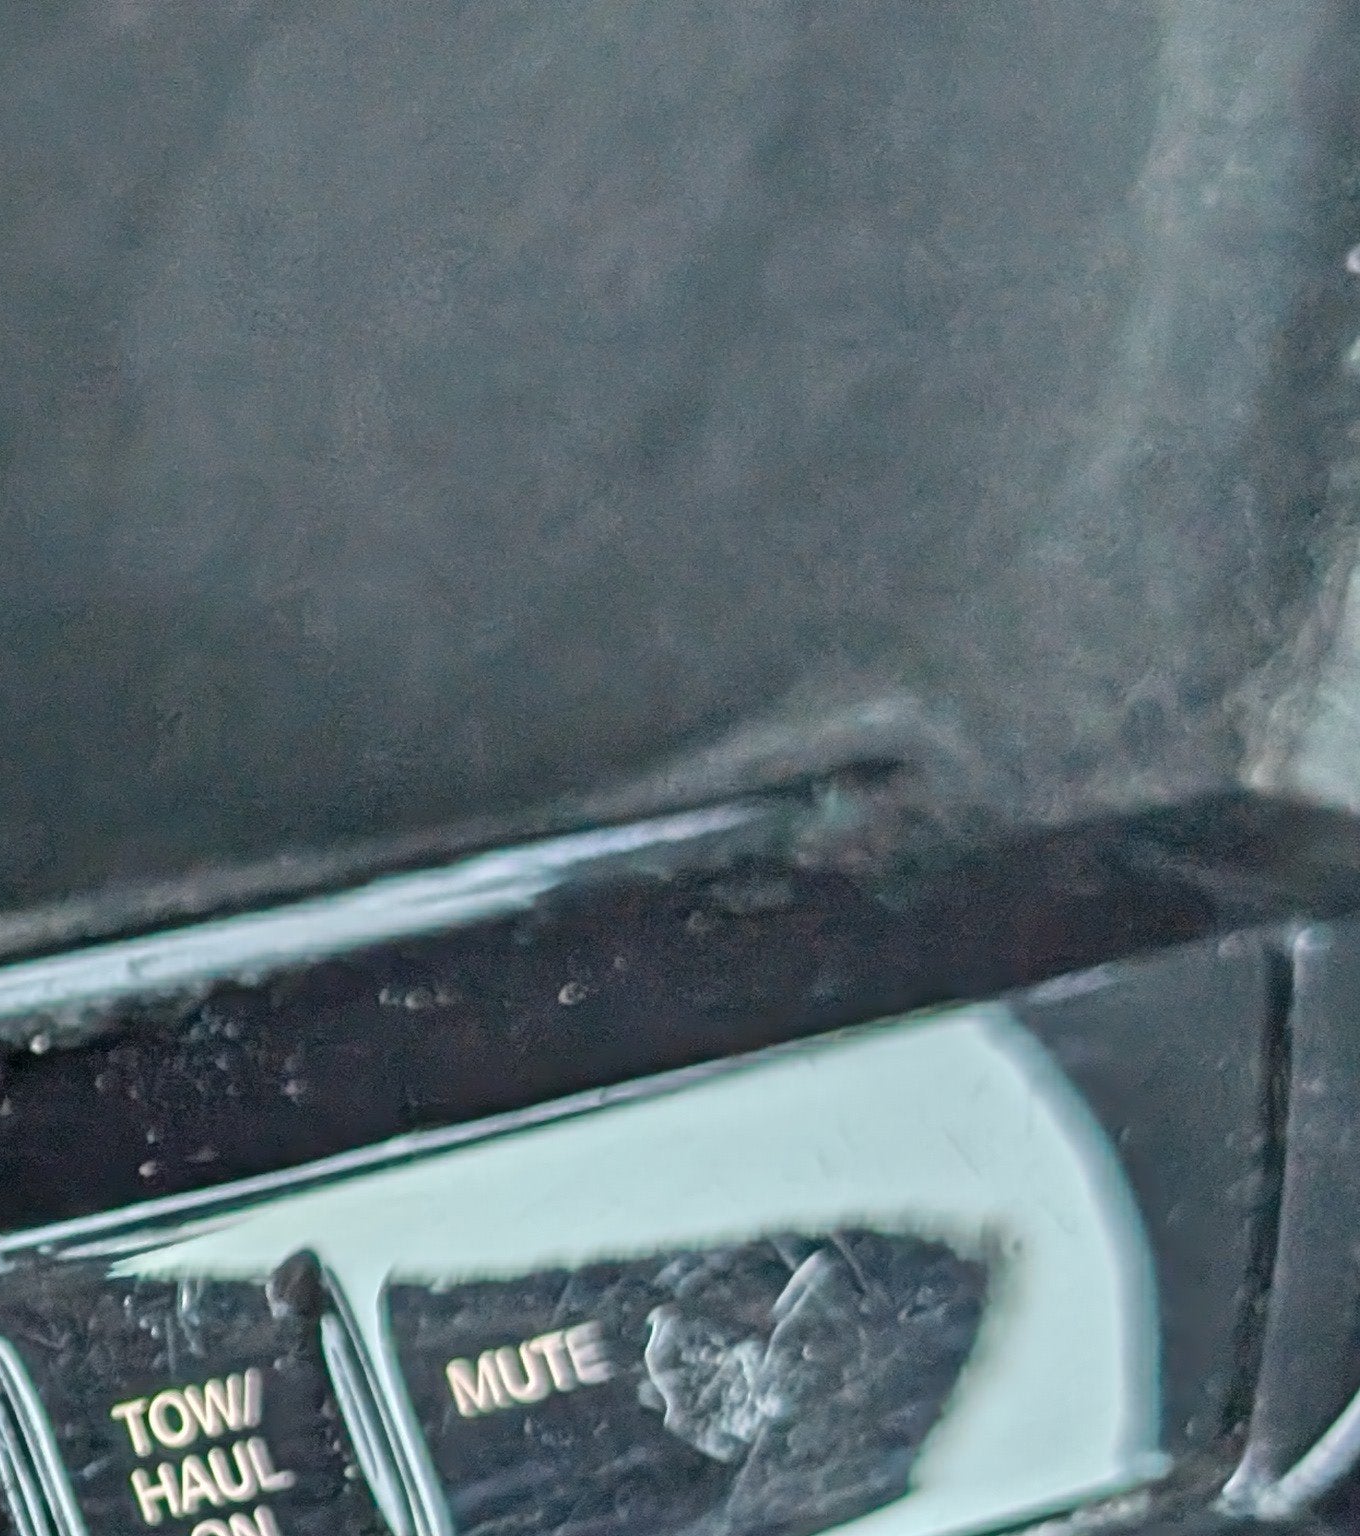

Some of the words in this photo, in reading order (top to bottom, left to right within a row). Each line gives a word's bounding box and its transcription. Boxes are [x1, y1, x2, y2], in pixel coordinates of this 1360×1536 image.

[112, 1367, 264, 1458] TOW/
[446, 1320, 615, 1418] MUTE
[131, 1437, 294, 1525] HAUL
